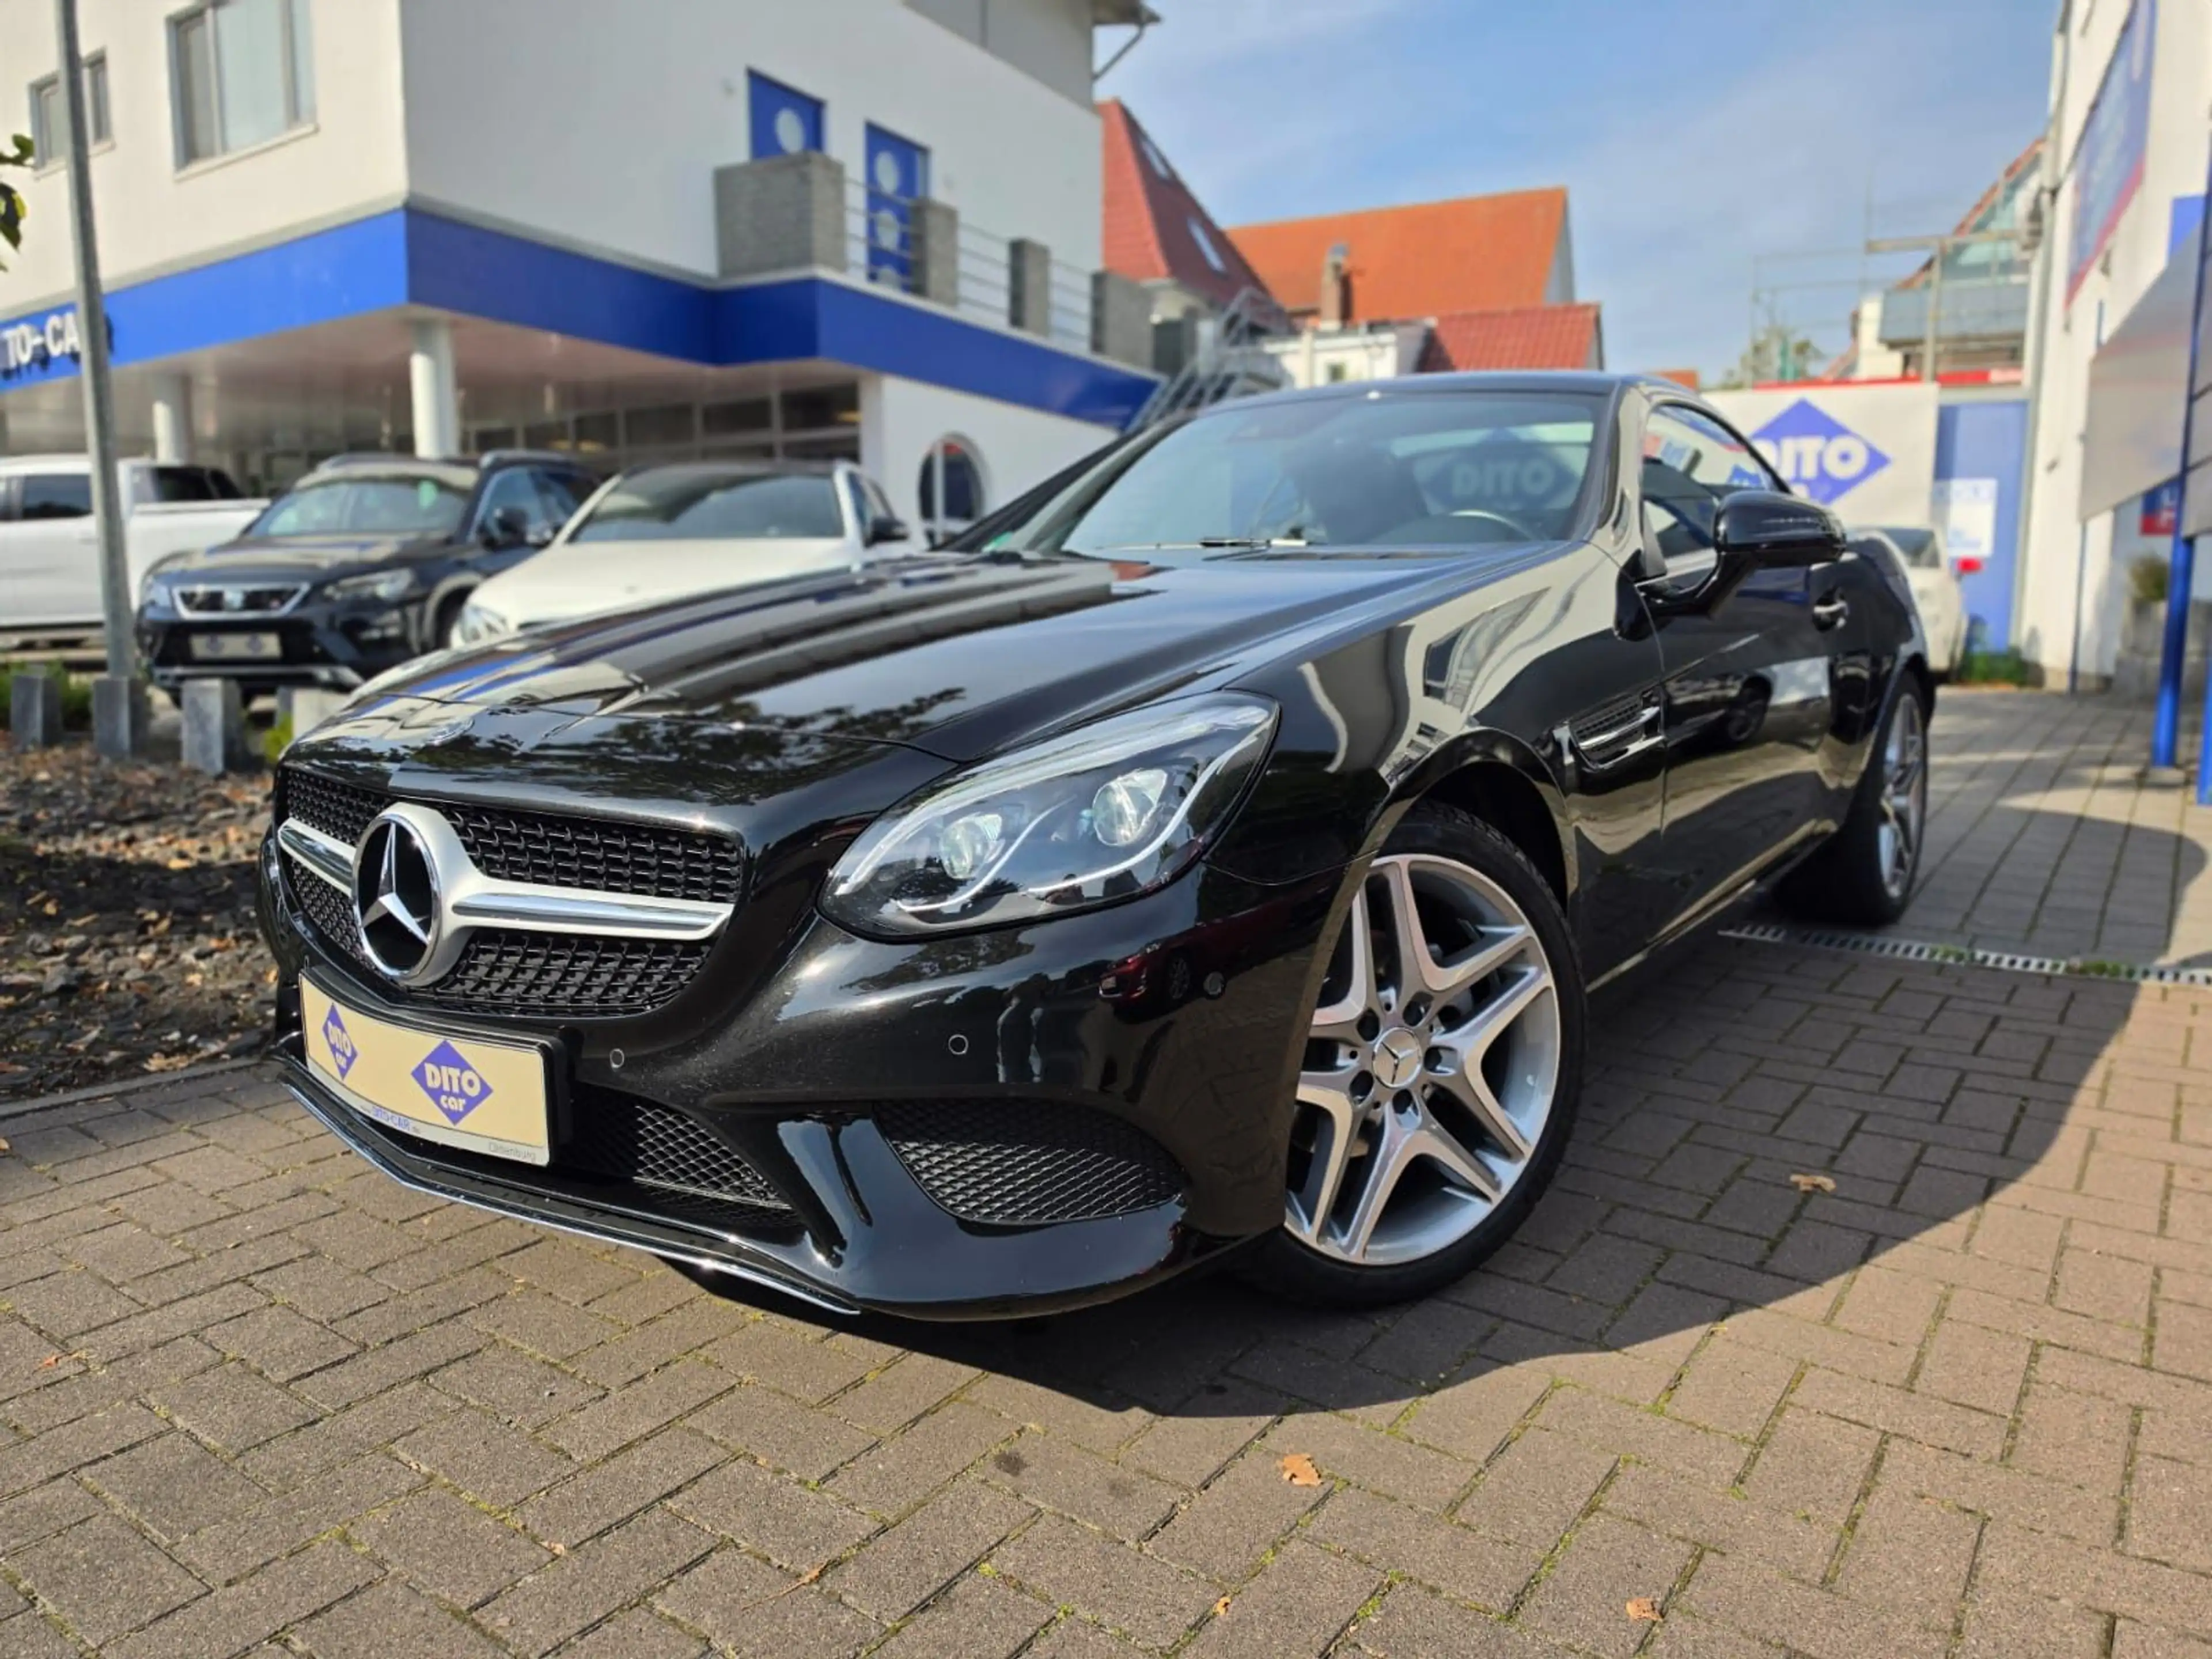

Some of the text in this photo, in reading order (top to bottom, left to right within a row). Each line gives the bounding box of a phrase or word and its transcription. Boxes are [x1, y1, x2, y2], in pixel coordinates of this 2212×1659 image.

[2, 312, 82, 370] TO-CA
[1751, 435, 1869, 482] DITO
[1452, 459, 1554, 498] DITO
[424, 1062, 481, 1097] DITO
[440, 1094, 466, 1112] car
